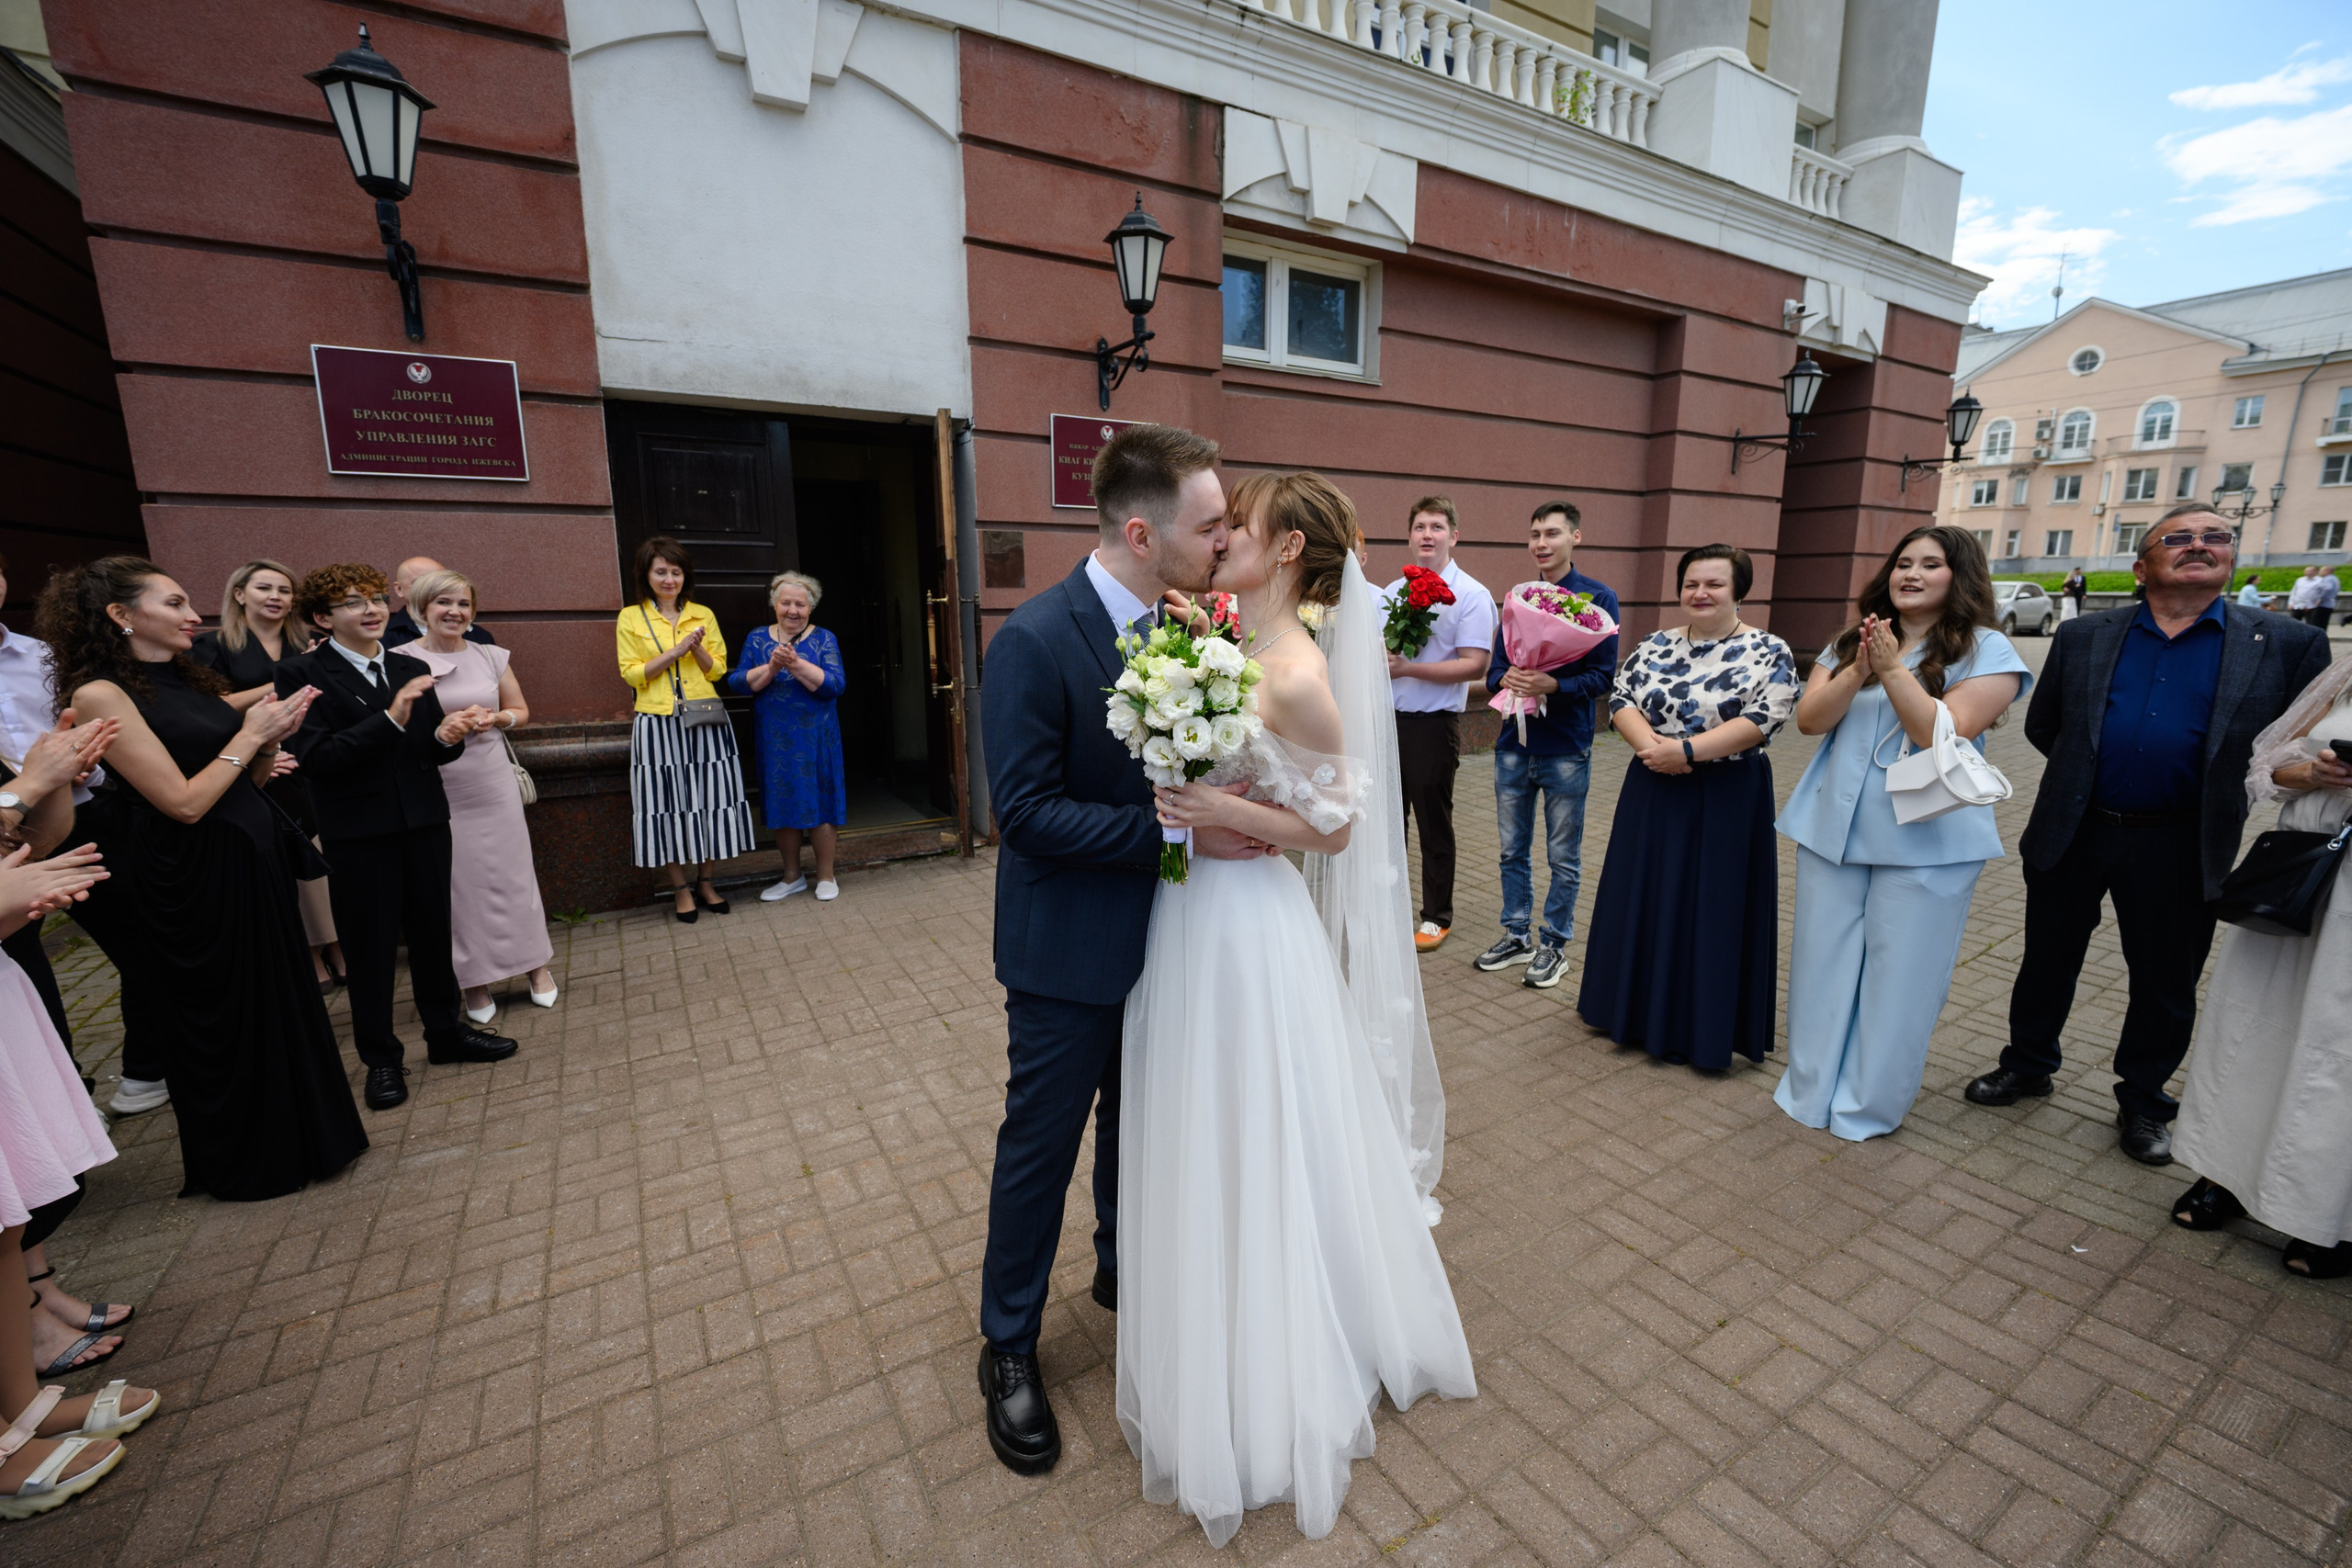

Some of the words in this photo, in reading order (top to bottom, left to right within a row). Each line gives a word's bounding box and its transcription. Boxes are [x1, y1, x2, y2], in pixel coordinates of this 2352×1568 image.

[392, 389, 453, 404] ДВОРЕЦ
[353, 409, 494, 426] БРАКОСОЧЕТАНИЯ
[356, 431, 458, 446] УПРАВЛЕНИЯ
[461, 435, 497, 447] ЗАГС
[340, 453, 427, 463] АДМИНИСТРАЦИИ
[432, 456, 468, 465] ГОРОДА
[471, 458, 516, 468] ИЖЕВСКА
